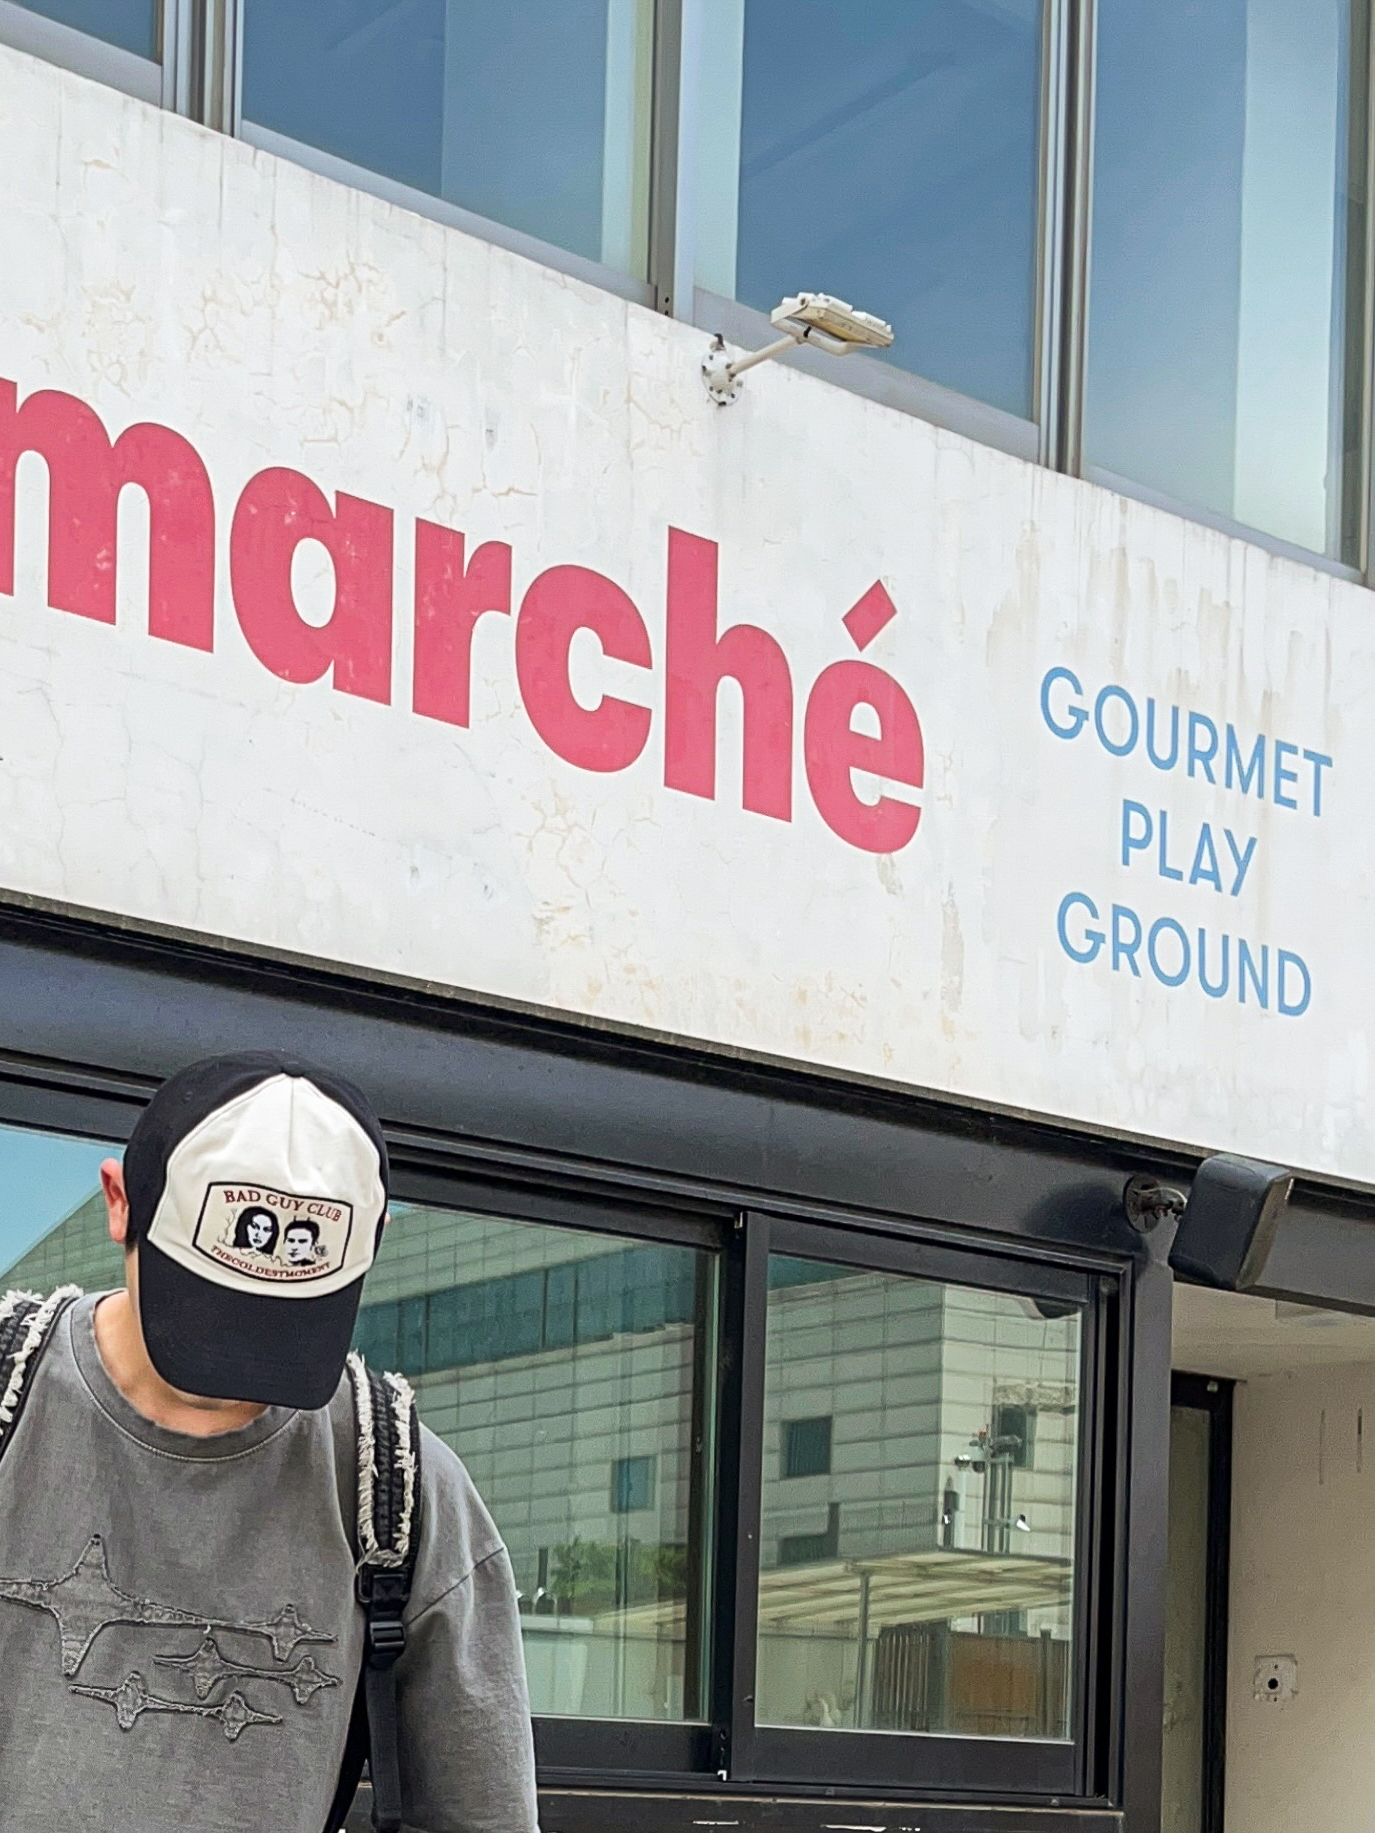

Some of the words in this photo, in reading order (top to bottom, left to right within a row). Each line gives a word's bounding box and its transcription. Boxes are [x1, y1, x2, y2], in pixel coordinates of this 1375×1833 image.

[1040, 666, 1333, 817] GOURMET
[1121, 798, 1258, 897] PLAY
[1057, 891, 1312, 1017] GROUND
[223, 1190, 261, 1204] BAD
[266, 1194, 305, 1211] GUY
[306, 1202, 342, 1222] CLUB
